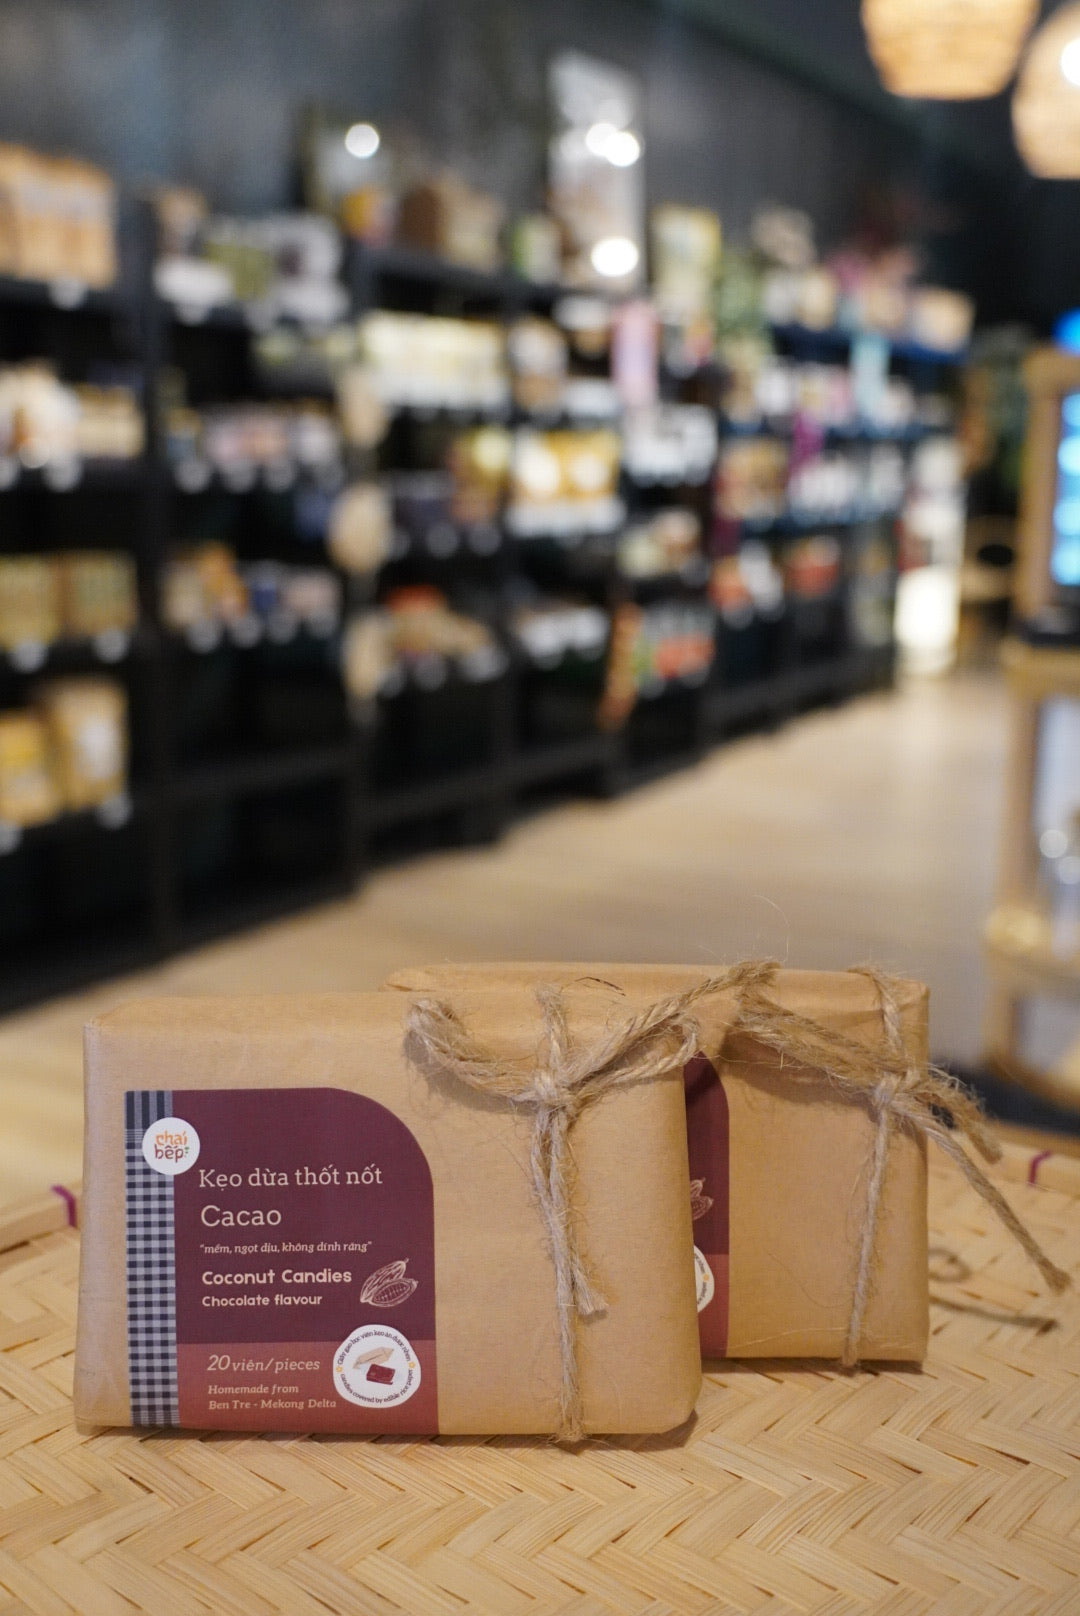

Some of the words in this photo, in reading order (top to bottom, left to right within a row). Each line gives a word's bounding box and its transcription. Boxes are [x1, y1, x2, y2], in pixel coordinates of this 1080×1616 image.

[199, 1169, 242, 1191] Kẹo
[248, 1167, 289, 1187] dừa
[295, 1164, 340, 1186] thốt
[345, 1163, 383, 1185] nốt
[200, 1204, 282, 1227] Cacao
[234, 1244, 258, 1255] ngọt
[282, 1241, 315, 1253] không
[316, 1241, 341, 1252] dính
[202, 1269, 275, 1285] Coconut
[281, 1268, 352, 1284] Candies
[202, 1294, 270, 1307] Chocolate
[274, 1293, 323, 1306] flavour
[207, 1354, 231, 1371] 20
[207, 1384, 269, 1395] Homemade
[271, 1383, 299, 1395] from
[208, 1400, 229, 1410] Ben
[232, 1399, 251, 1409] Tre
[260, 1399, 304, 1409] Mekong
[307, 1398, 337, 1408] Delta
[375, 1397, 383, 1405] by
